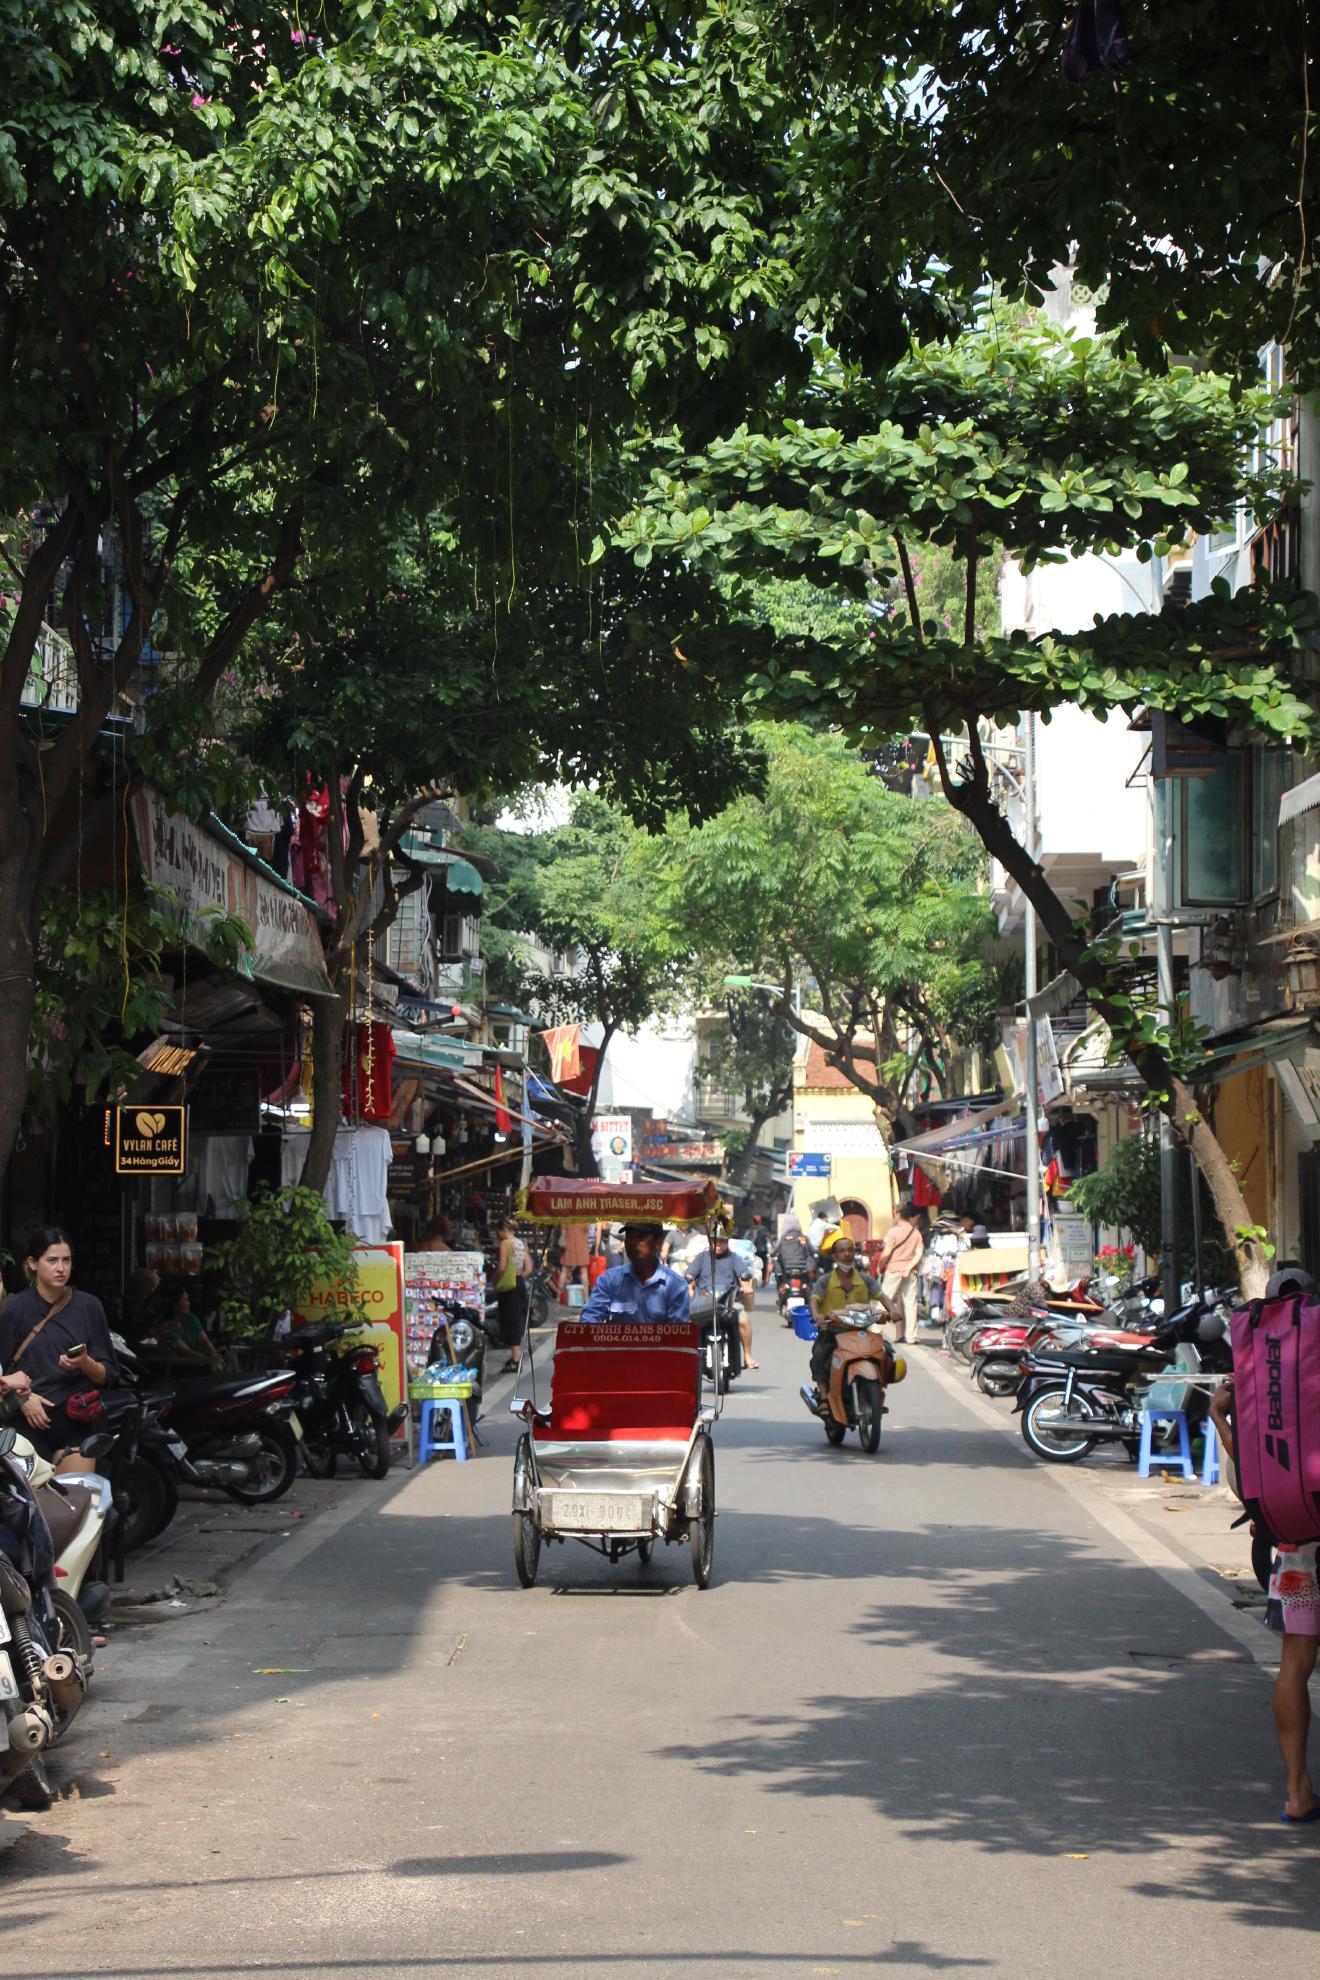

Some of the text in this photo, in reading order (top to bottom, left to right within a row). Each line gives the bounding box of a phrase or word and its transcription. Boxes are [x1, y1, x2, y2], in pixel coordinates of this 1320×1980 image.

[123, 1137, 178, 1151] VYLAN CAFÉ
[120, 1154, 180, 1167] 34 Hàng Giấy
[551, 1197, 573, 1210] LAM
[575, 1198, 597, 1210] ANH
[310, 1290, 384, 1305] HABECO
[564, 1324, 691, 1335] CTY TNHH SANS SOUCI
[1265, 1333, 1283, 1431] Babolat
